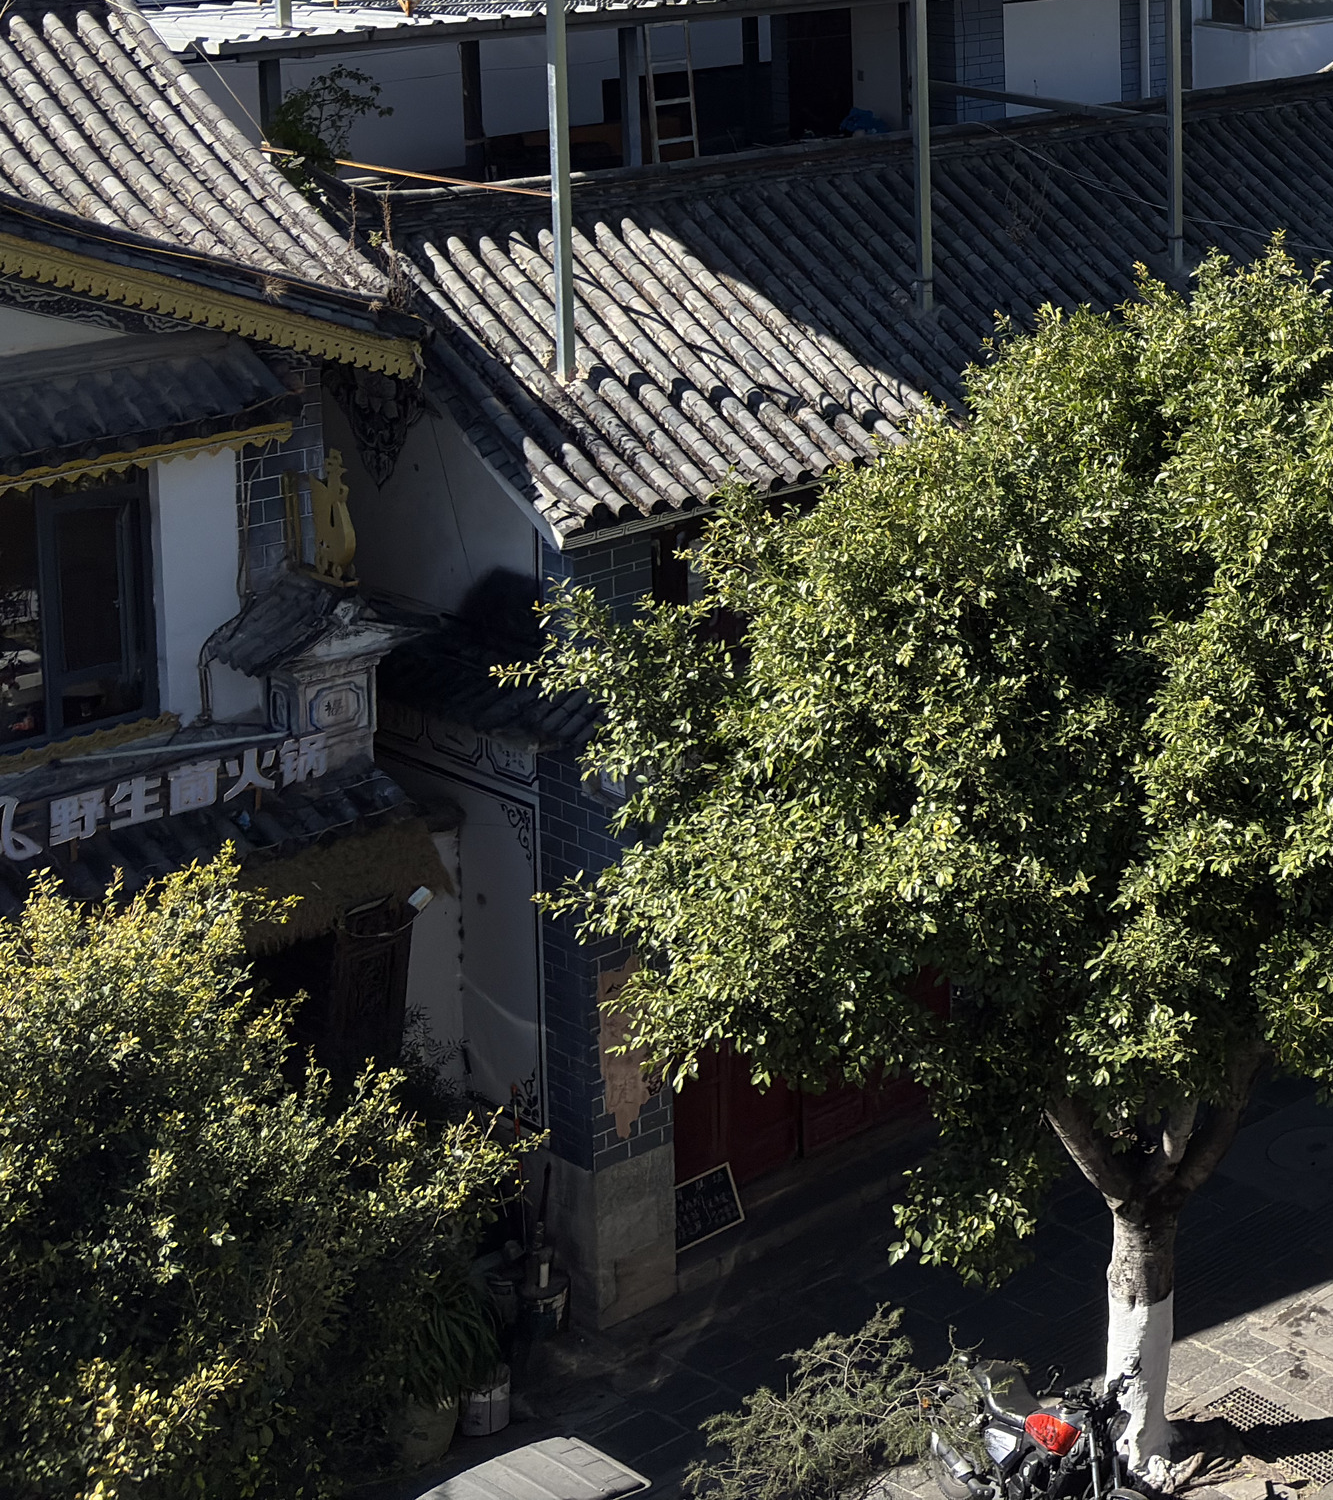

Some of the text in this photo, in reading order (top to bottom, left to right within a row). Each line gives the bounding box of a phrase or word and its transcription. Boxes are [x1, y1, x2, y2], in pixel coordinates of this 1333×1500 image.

[48, 731, 328, 847] 野生菌火锅
